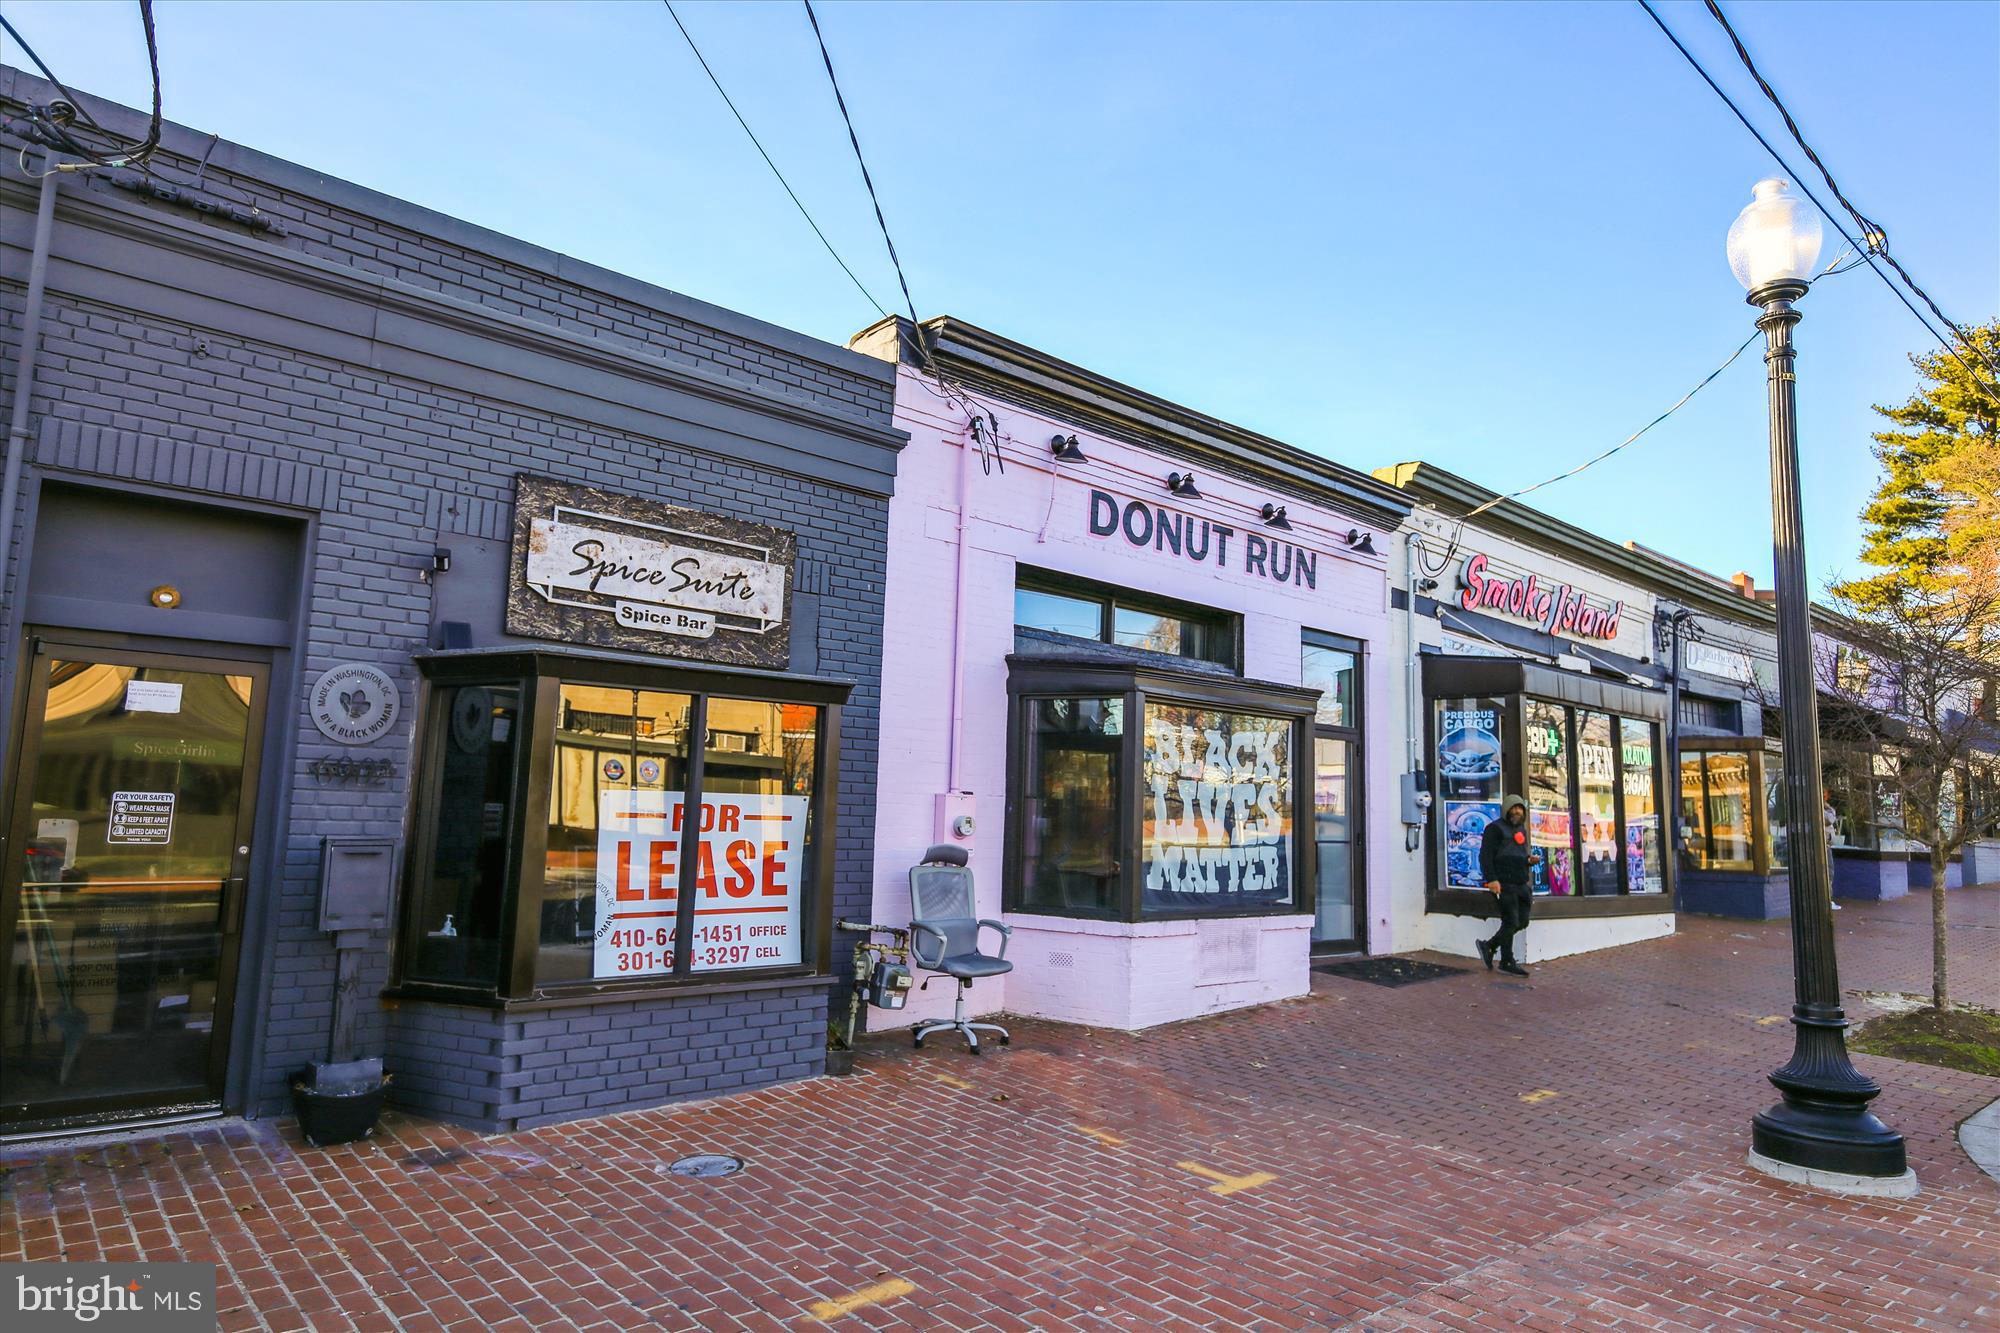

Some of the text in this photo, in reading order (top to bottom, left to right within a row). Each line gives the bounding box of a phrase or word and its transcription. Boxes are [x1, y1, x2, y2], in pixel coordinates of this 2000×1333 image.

[1089, 489, 1317, 590] DONUT RUN
[568, 539, 756, 601] Spice Suite
[1458, 553, 1624, 640] Smoke Island
[621, 606, 707, 630] Spice Bar
[318, 669, 392, 707] MADE IN WASHINGTON, DC
[320, 703, 393, 738] BY A BLACK WOMAN
[1444, 711, 1494, 719] PRECIOUS
[1444, 719, 1494, 729] CARGO
[1152, 718, 1282, 780] BLACK
[1622, 772, 1651, 797] CIGAR
[154, 816, 168, 824] APART
[672, 803, 740, 833] FOR
[1151, 775, 1282, 845] LIVES
[616, 839, 789, 902] LEASE
[1147, 844, 1279, 893] MATTER
[610, 924, 787, 948] 410-64-1451 OFFICE
[617, 945, 781, 972] 301-64-3297 CELL
